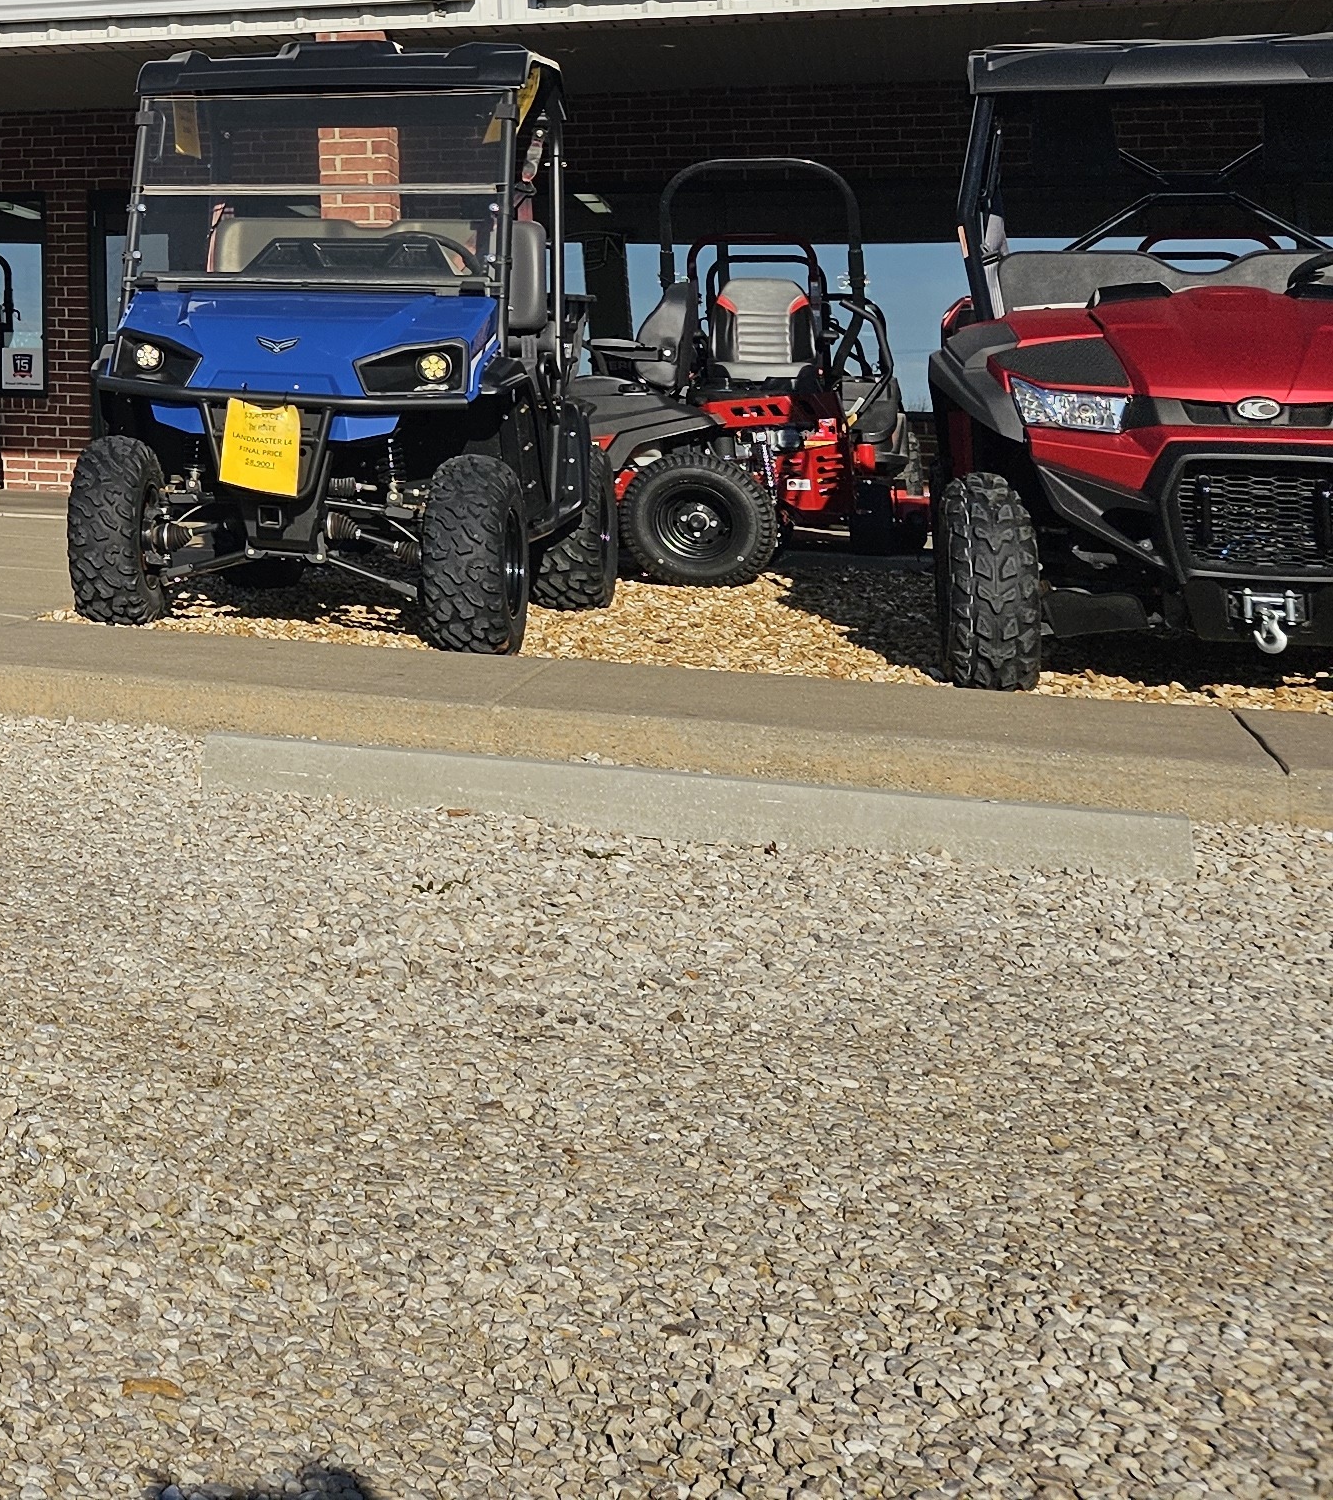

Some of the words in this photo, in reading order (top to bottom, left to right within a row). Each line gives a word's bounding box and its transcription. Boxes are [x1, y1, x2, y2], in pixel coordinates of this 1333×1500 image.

[15, 359, 29, 371] 15
[232, 432, 282, 445] LANDMASTER
[239, 445, 260, 455] FINAL
[262, 449, 283, 457] PRICE
